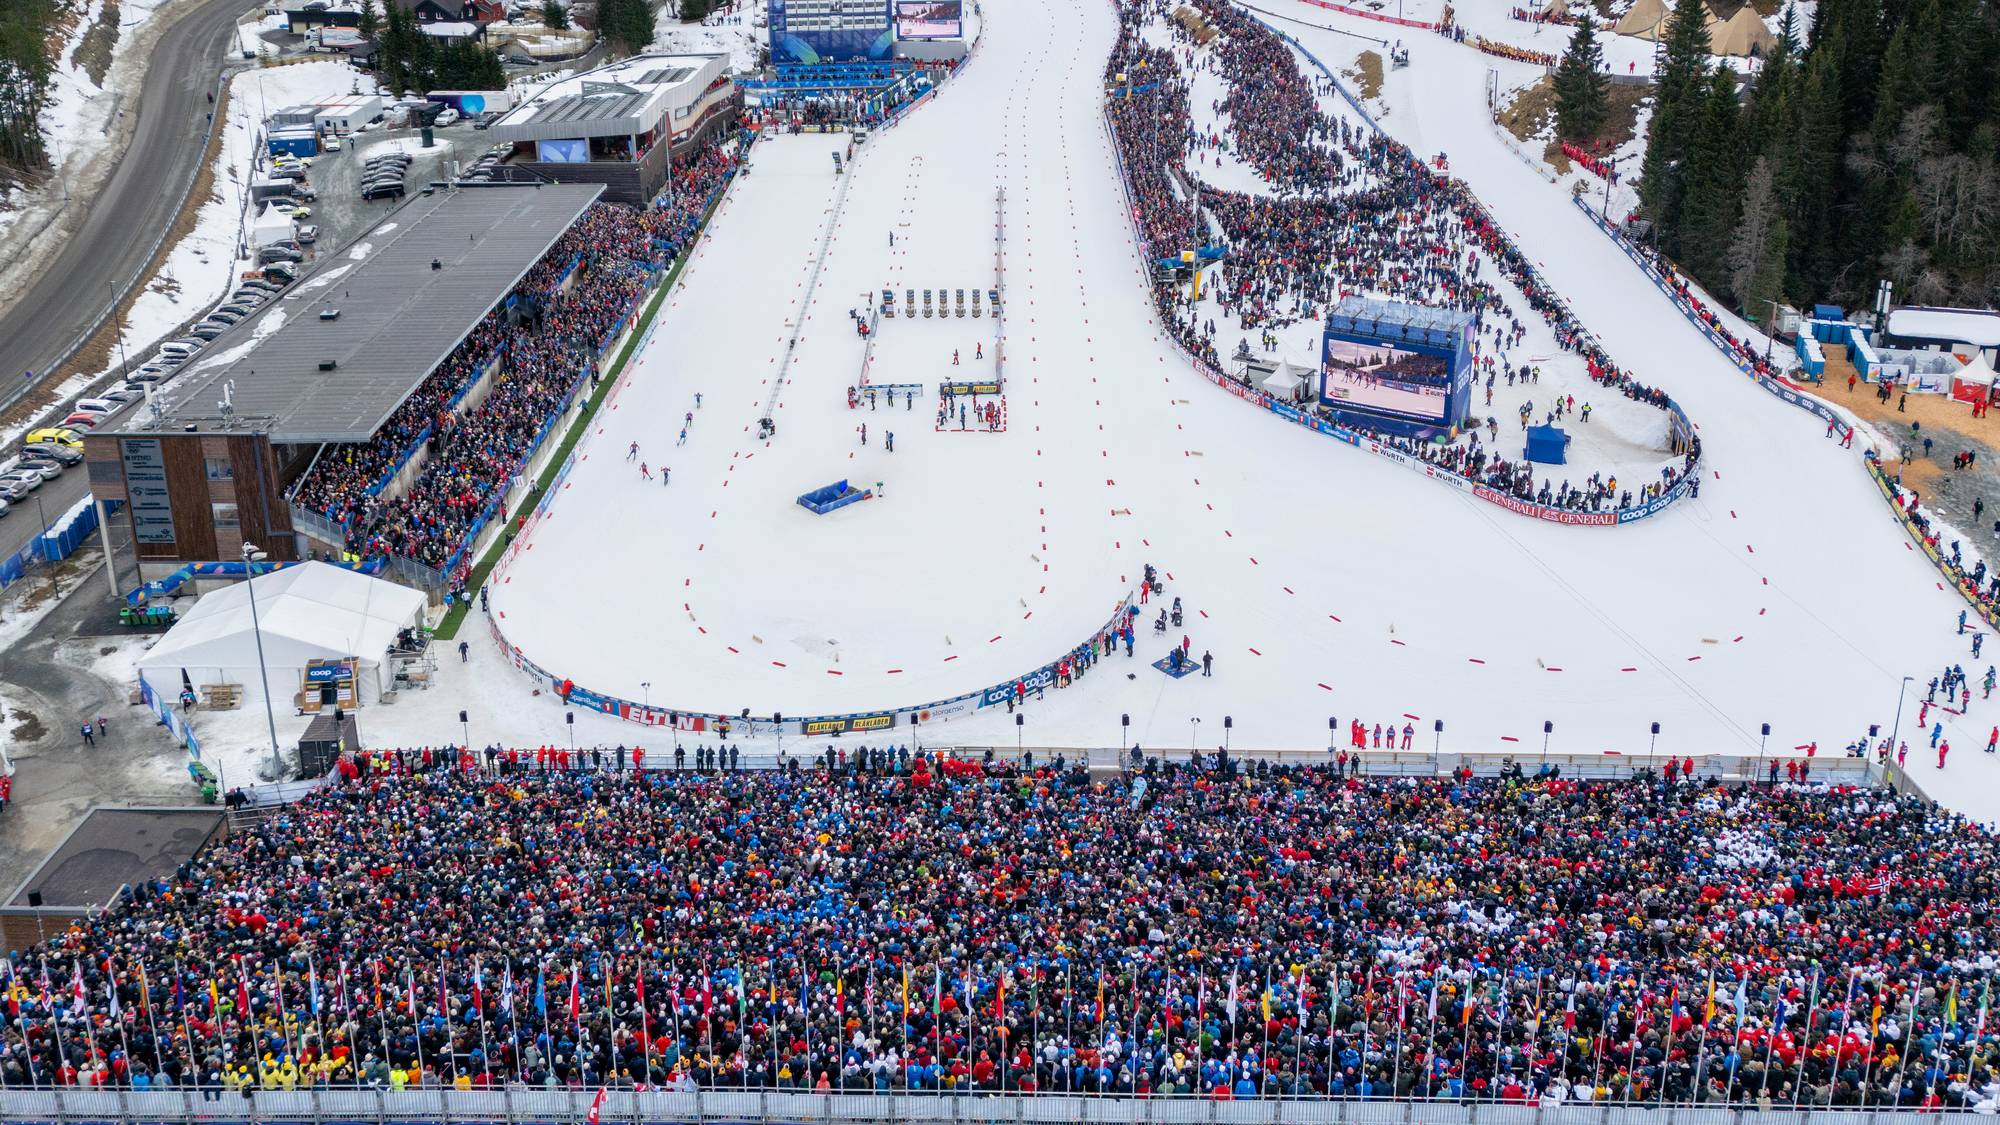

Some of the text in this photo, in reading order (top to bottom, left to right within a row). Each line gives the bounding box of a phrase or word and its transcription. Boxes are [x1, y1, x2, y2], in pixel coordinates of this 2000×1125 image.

[1661, 283, 1672, 297] coop
[1677, 300, 1689, 314] coop
[1711, 334, 1724, 349] coop
[1195, 362, 1260, 405] ELTEN SAFETY SHOES
[1767, 381, 1779, 393] coop
[1784, 391, 1797, 402] coop
[1802, 398, 1815, 410] coop
[1820, 407, 1833, 421] coop
[1380, 448, 1405, 463] WÜRTH
[1435, 470, 1463, 487] WÜRTH
[1488, 493, 1536, 517] GENERALI
[1621, 496, 1671, 521] coop coop
[1559, 512, 1614, 525] GENERALI
